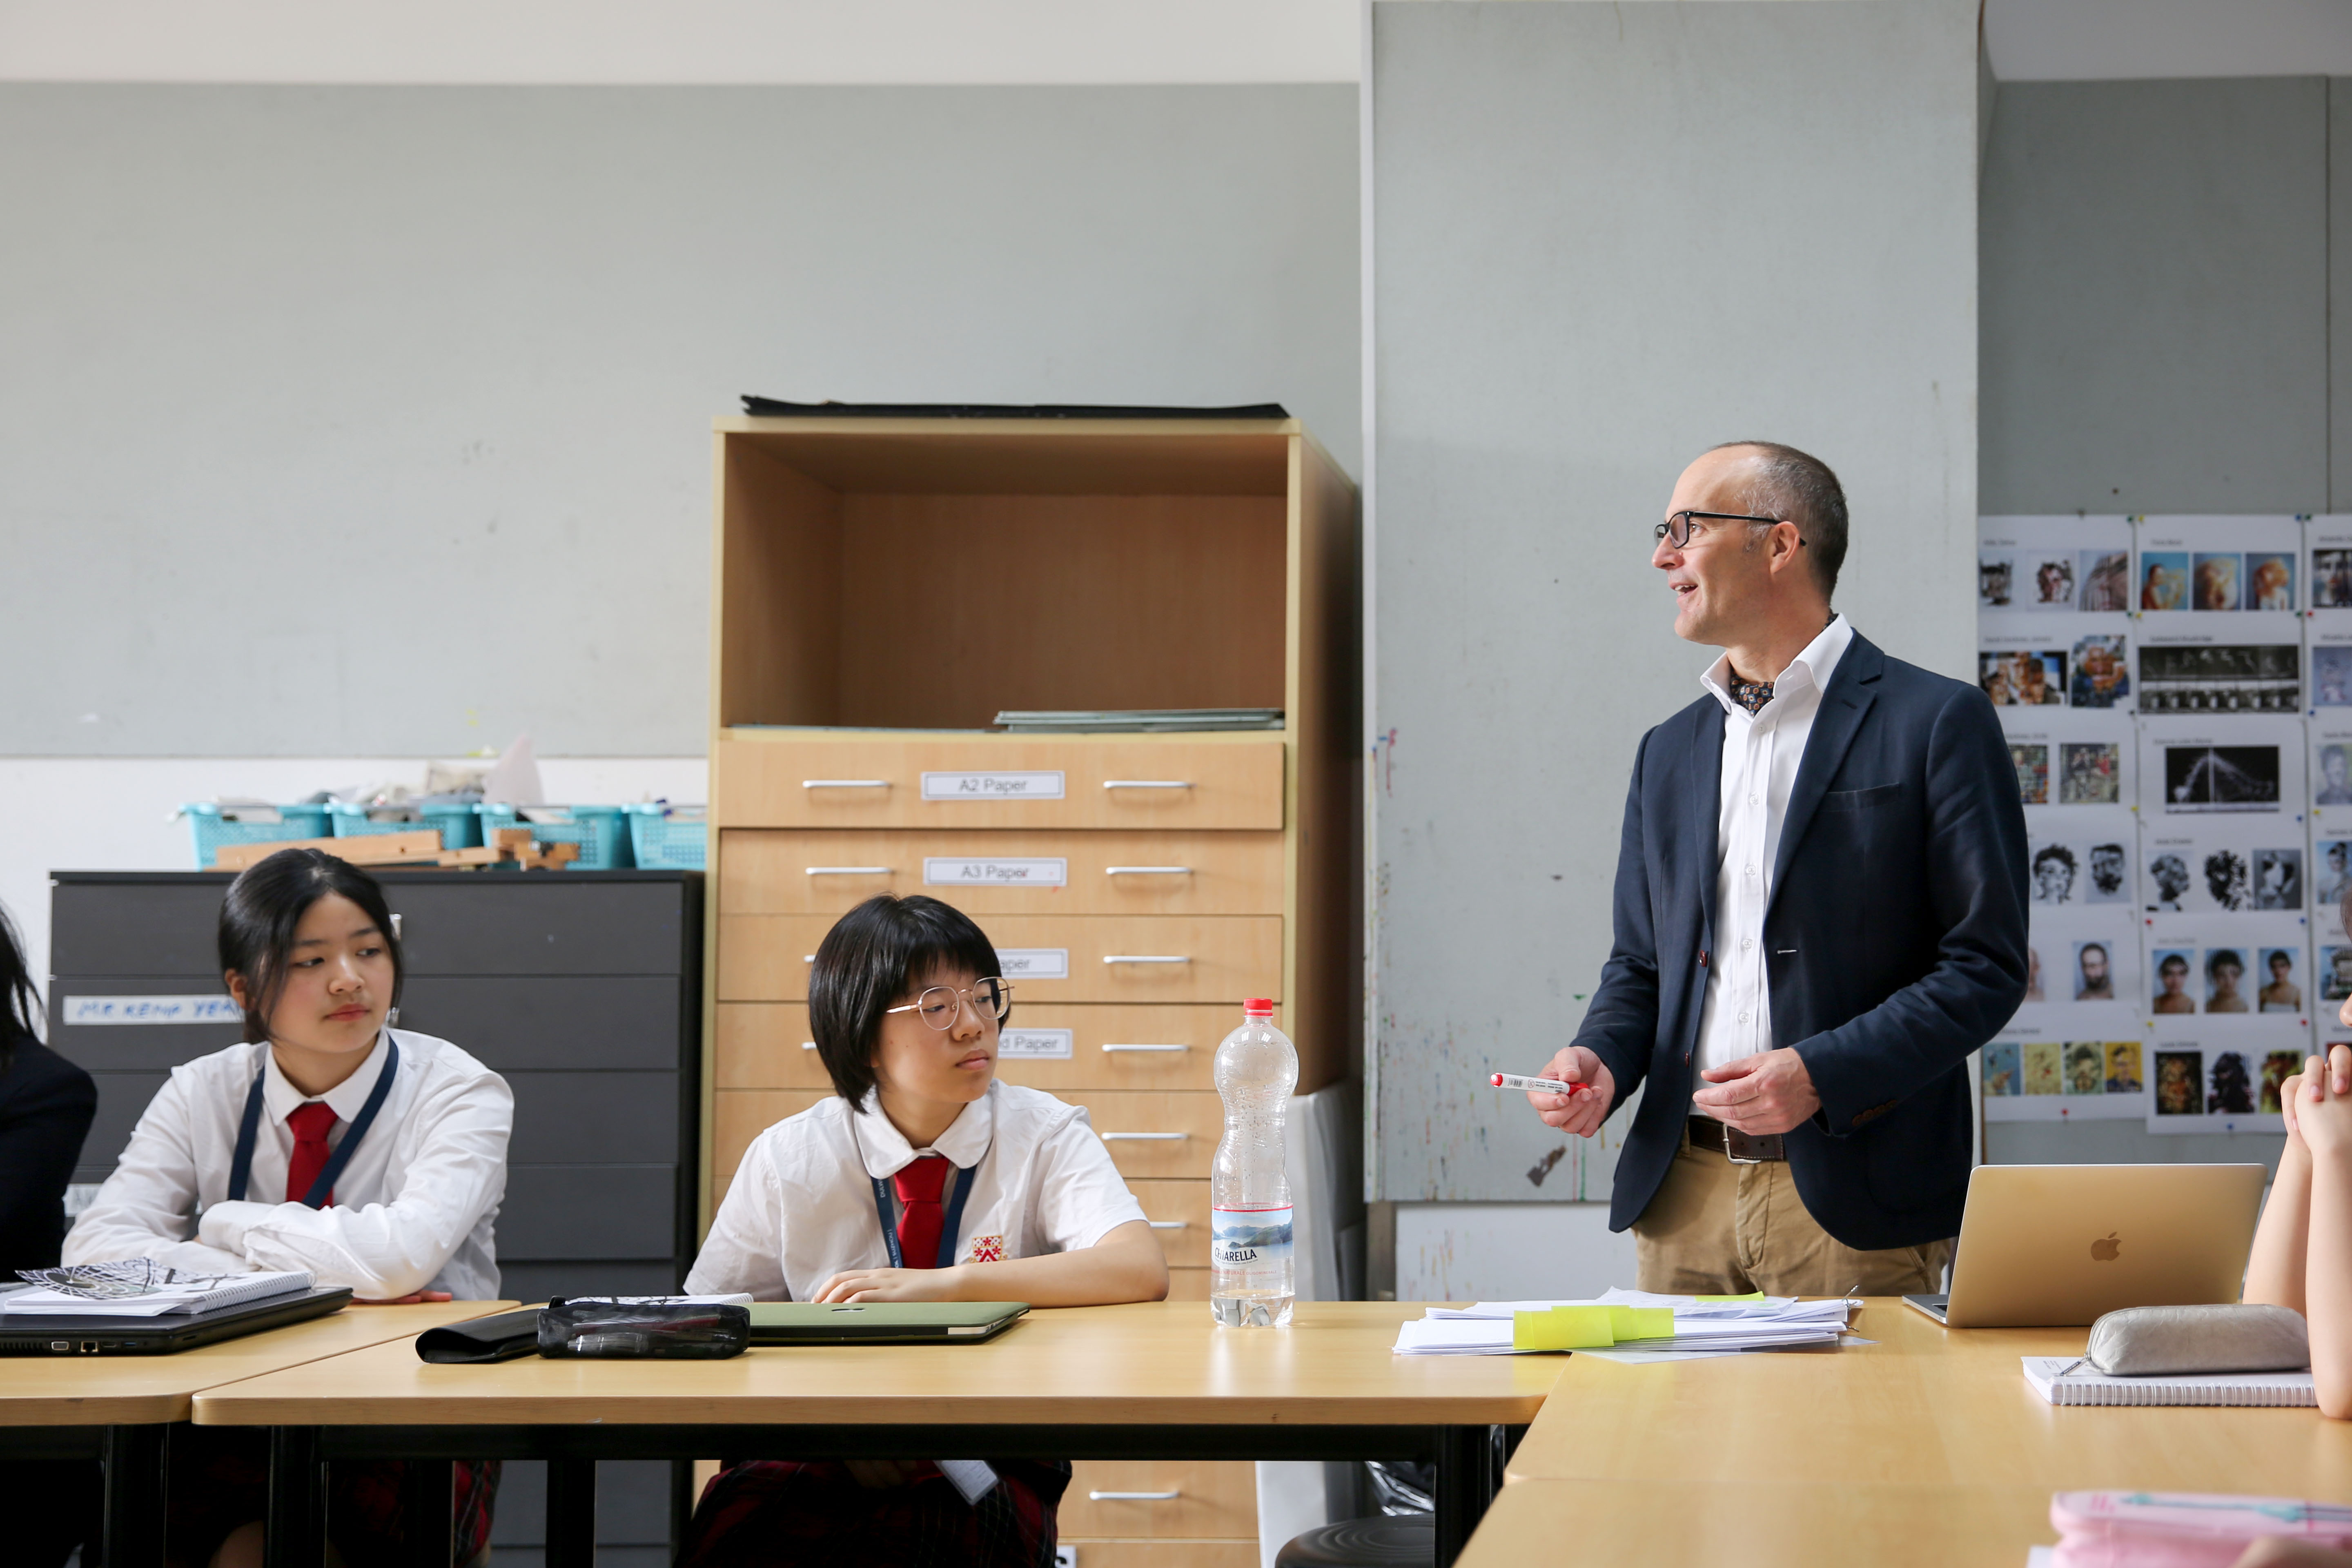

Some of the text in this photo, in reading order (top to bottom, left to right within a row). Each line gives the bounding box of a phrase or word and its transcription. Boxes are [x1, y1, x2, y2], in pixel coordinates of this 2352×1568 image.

[959, 777, 1028, 795] A2 Paper
[960, 864, 1030, 881] A3 Paper
[1000, 960, 1031, 973] aper
[1014, 1035, 1058, 1052] Paper
[1215, 1247, 1258, 1261] CHIARELLA
